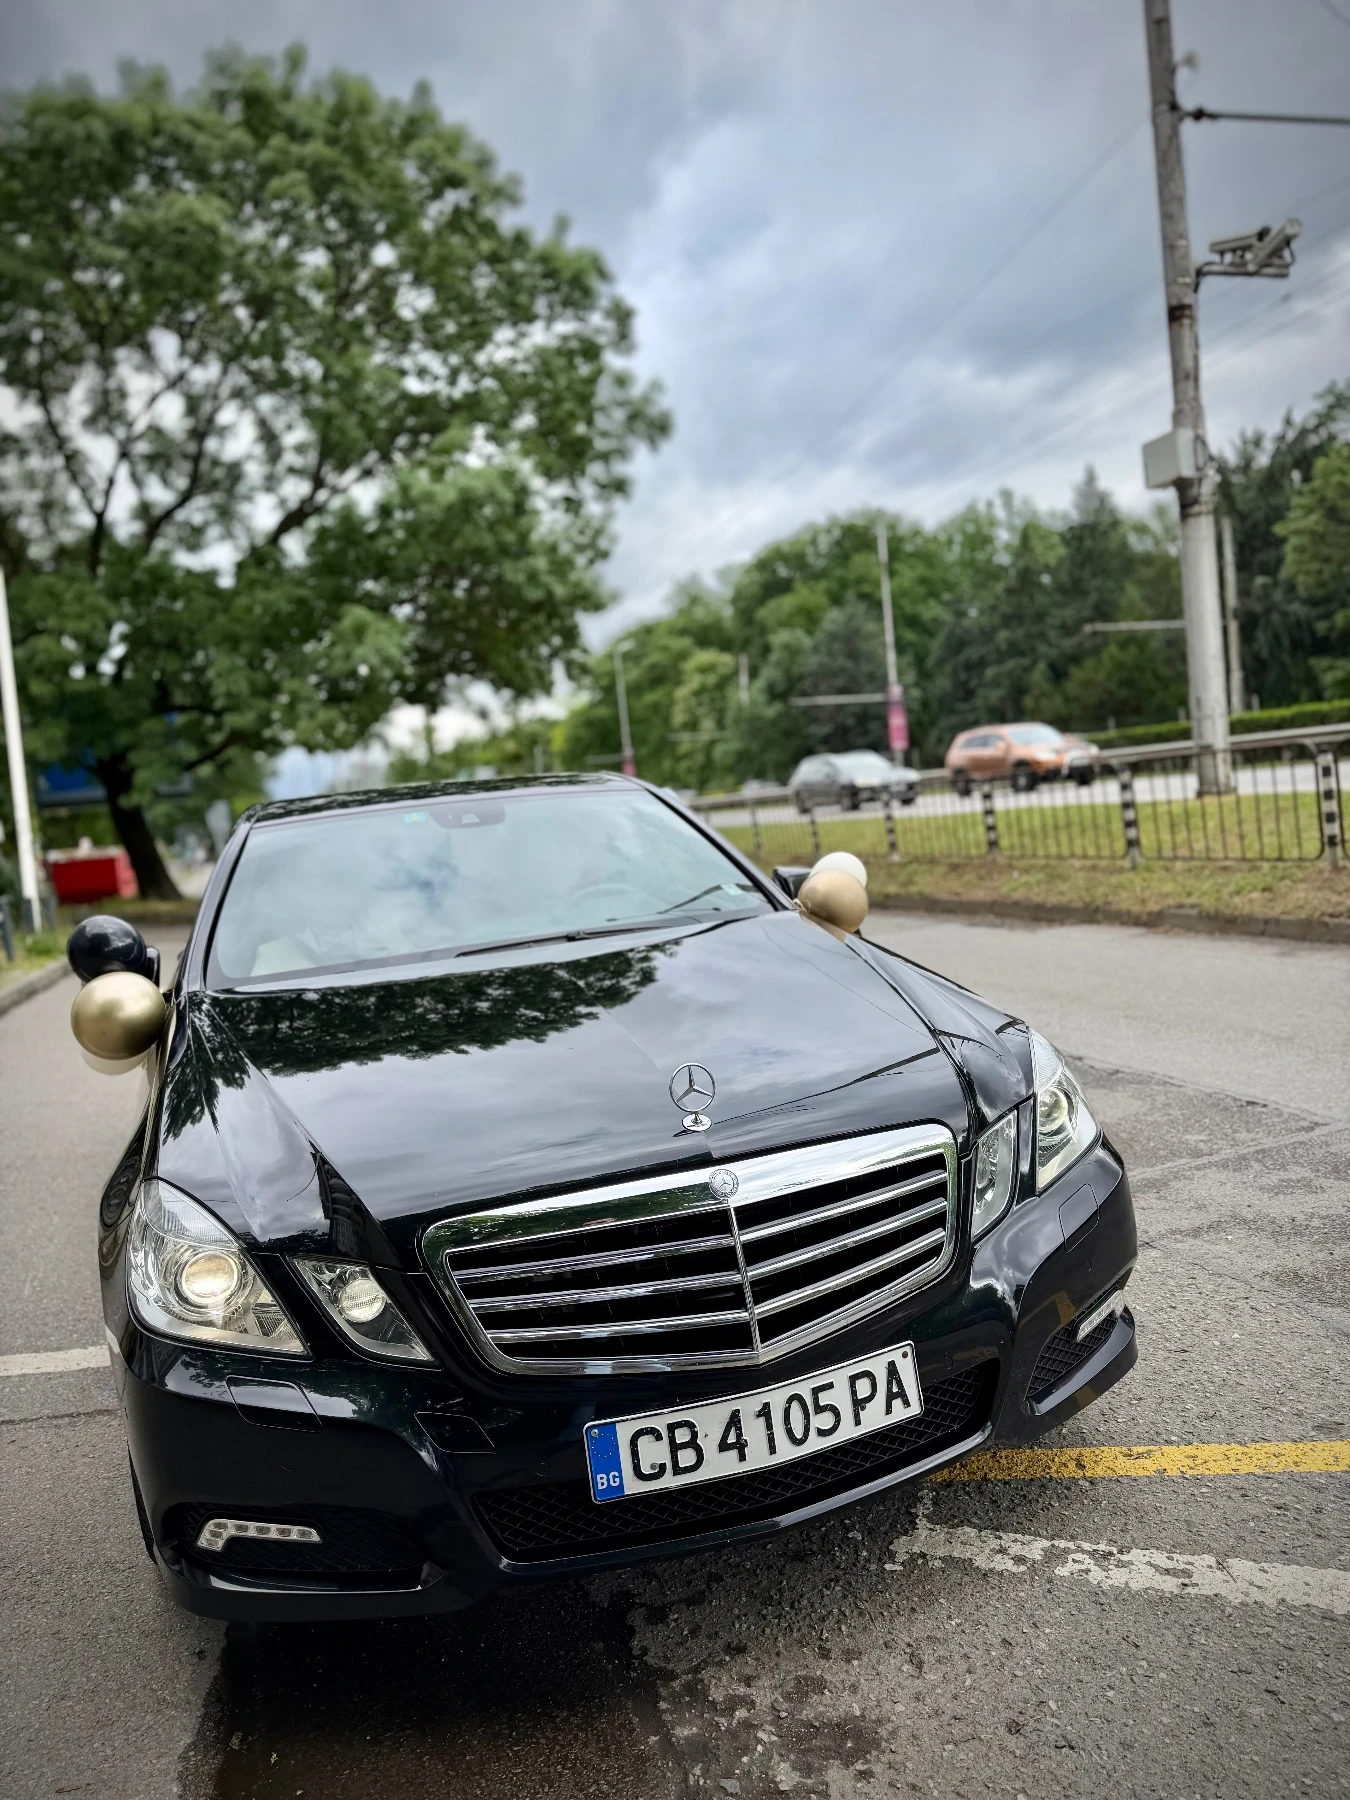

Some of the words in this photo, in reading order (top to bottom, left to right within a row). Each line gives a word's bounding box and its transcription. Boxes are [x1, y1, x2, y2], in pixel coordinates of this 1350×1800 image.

[629, 1419, 705, 1482] CB
[718, 1381, 842, 1463] 4105
[849, 1359, 912, 1427] PA
[596, 1471, 620, 1490] BG
